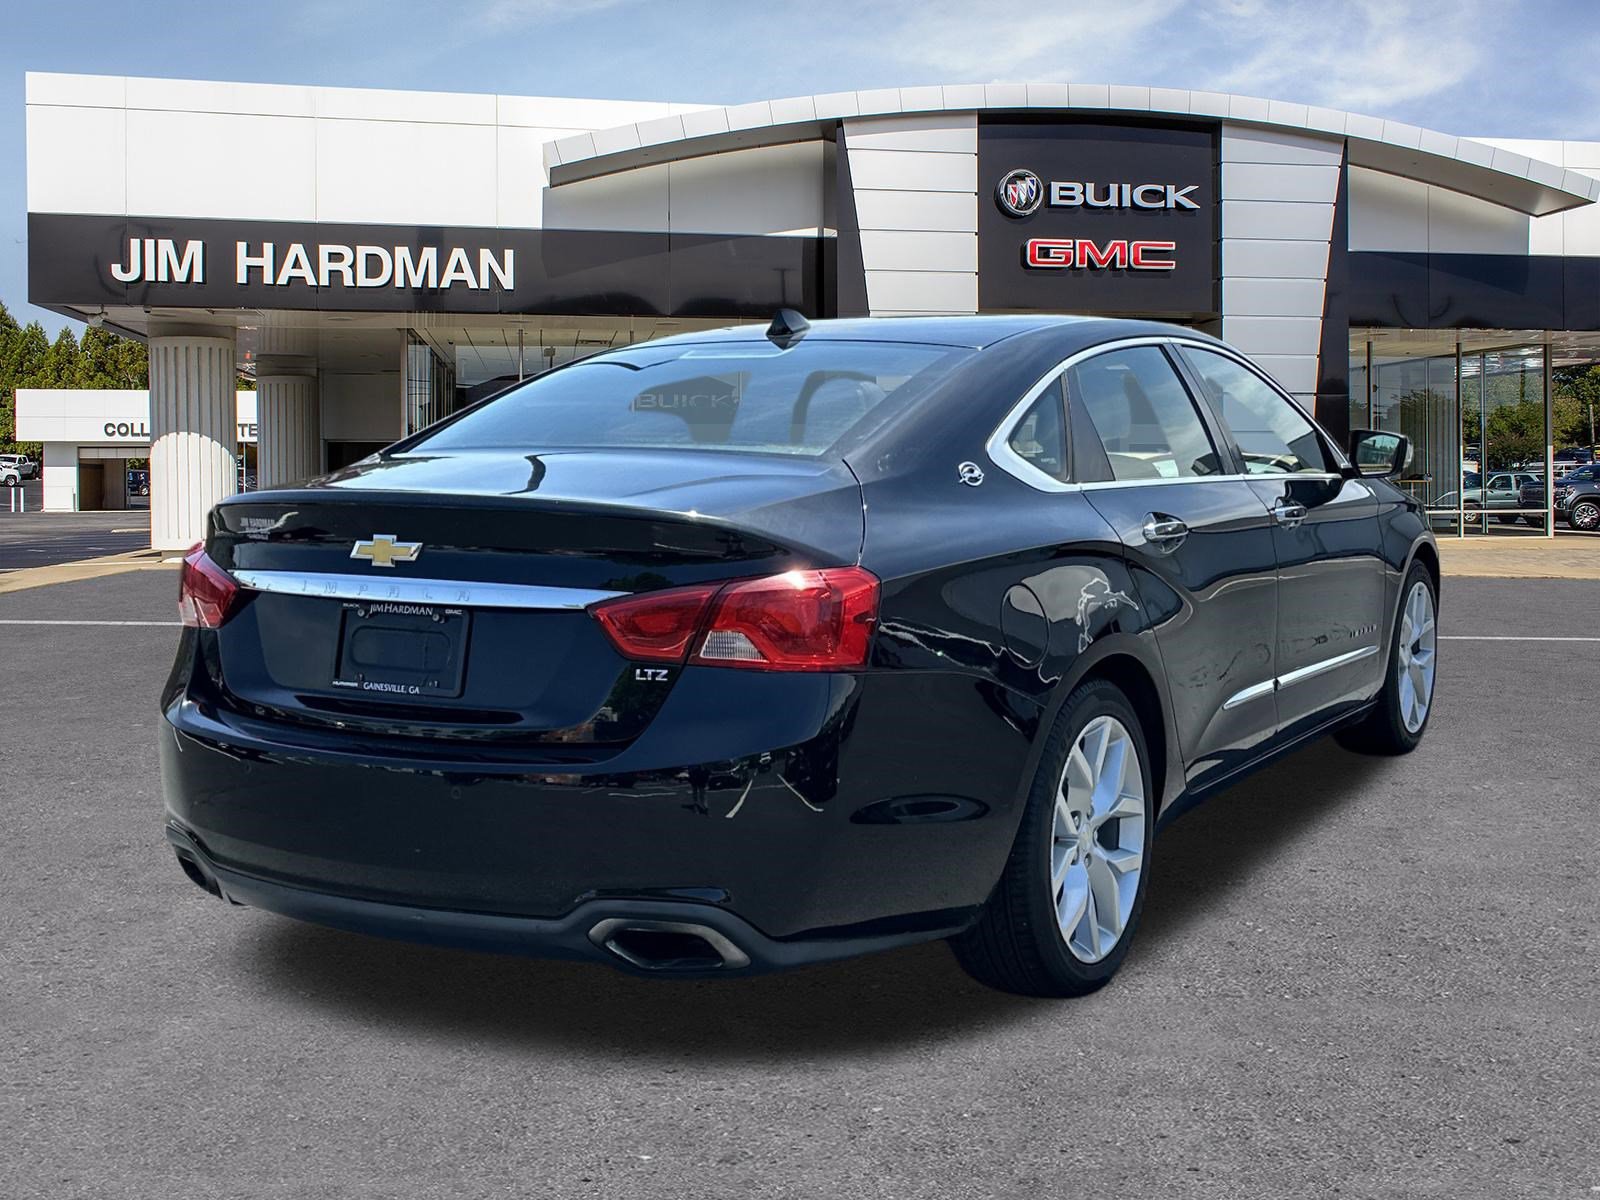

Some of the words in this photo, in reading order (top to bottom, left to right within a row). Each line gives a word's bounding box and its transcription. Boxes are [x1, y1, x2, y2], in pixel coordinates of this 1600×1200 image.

[1050, 181, 1201, 209] BUICK
[111, 238, 204, 282] JIM
[236, 240, 515, 291] HARDMAN
[1026, 238, 1177, 270] GMC
[104, 422, 150, 437] COLL
[237, 423, 258, 438] TE
[302, 580, 471, 601] IMPALA
[635, 668, 669, 681] LTZ
[408, 685, 420, 695] GA
